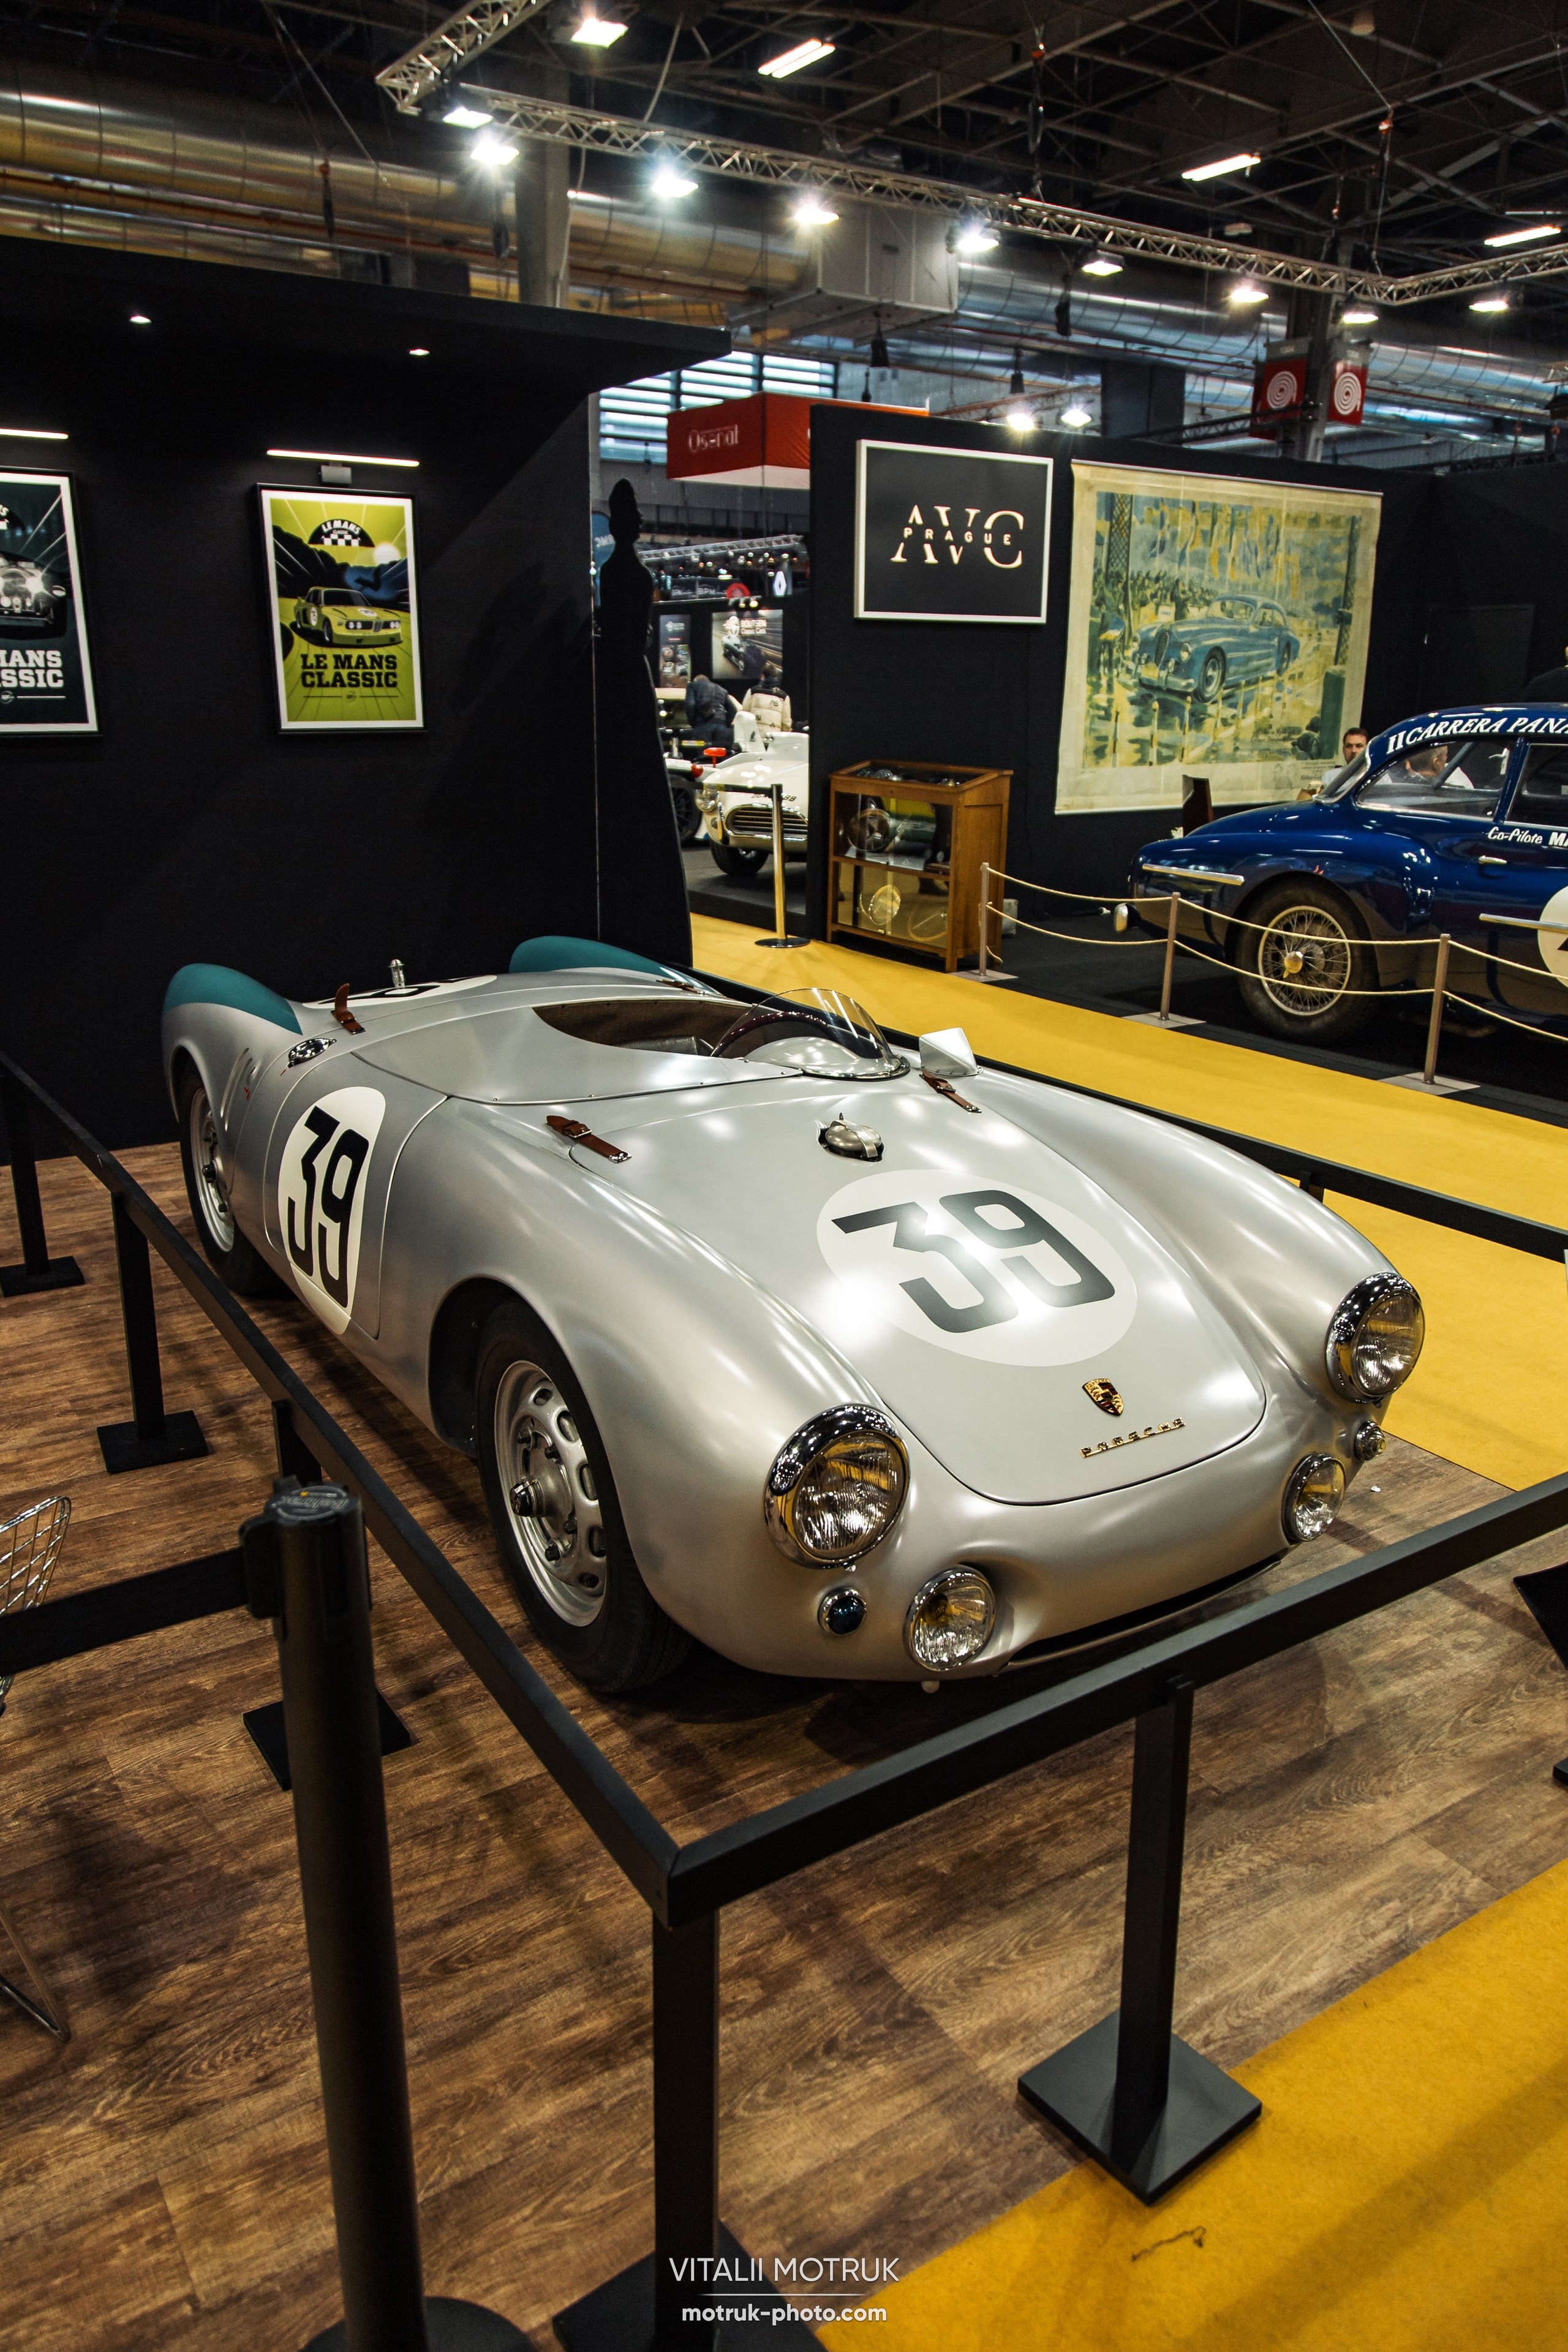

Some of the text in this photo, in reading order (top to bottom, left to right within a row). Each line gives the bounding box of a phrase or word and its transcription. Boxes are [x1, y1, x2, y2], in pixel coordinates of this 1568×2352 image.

[321, 519, 361, 535] LE MANS
[903, 527, 1011, 546] PRAGUE
[300, 653, 398, 671] LE MANS
[0, 668, 65, 688] SSIC
[301, 671, 398, 688] CLASSIC
[1386, 731, 1406, 755] II
[1404, 717, 1508, 745] CARRERA
[1487, 826, 1543, 844] Co-Pilote
[287, 1105, 370, 1308] 39
[831, 1189, 1115, 1333] 39
[1079, 1417, 1186, 1458] PORSCHE
